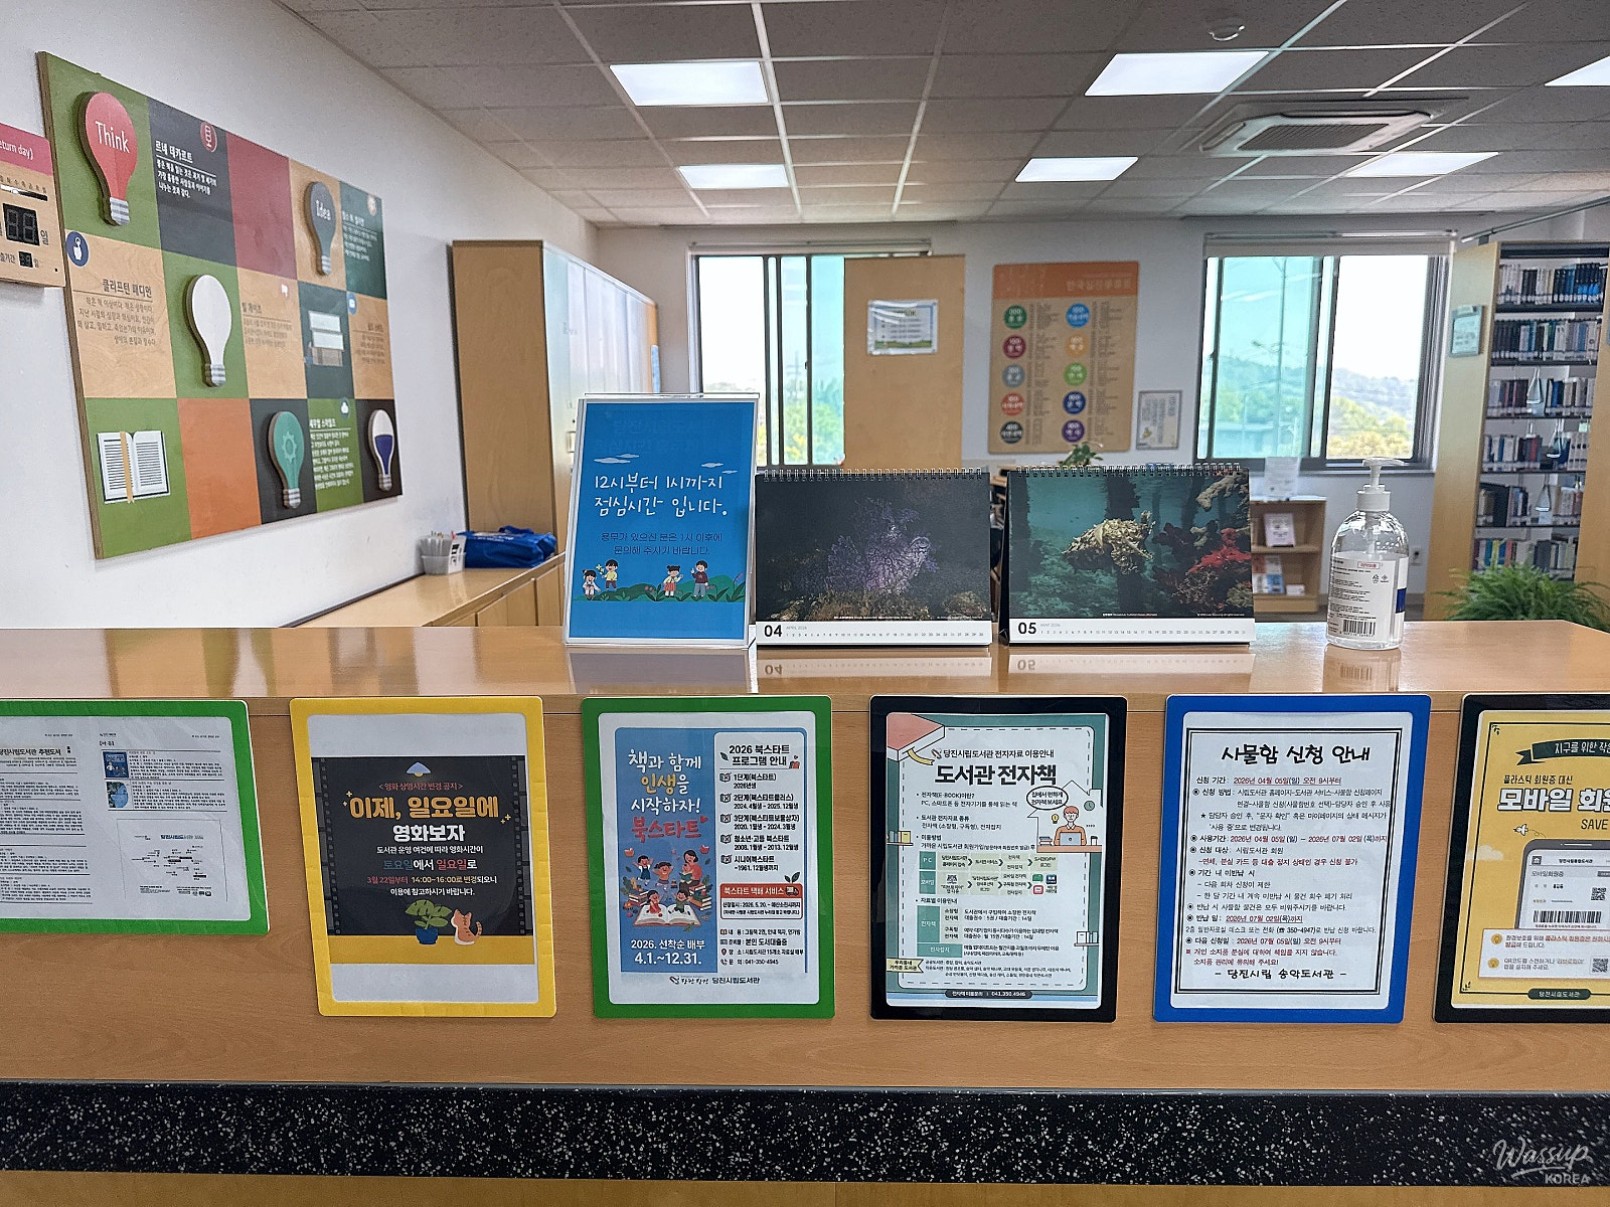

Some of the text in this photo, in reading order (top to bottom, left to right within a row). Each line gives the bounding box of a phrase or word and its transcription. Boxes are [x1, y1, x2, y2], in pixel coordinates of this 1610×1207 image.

[95, 121, 130, 153] Think
[18, 146, 33, 160] day)
[156, 140, 193, 163] 르네 데카르트
[316, 199, 331, 220] Idea
[103, 279, 130, 296] 클리프턴
[595, 472, 723, 494] 12시부터 1시까지
[595, 497, 728, 518] 점심시간 입니다.
[630, 532, 657, 542] 있으신
[660, 532, 677, 541] 분은
[696, 532, 723, 541] 이후에
[614, 546, 641, 555] 문의해
[644, 546, 670, 555] 주시기
[764, 624, 782, 637] 04
[1018, 622, 1037, 634] 05
[729, 745, 790, 754] 2026 북스타트
[943, 749, 1054, 758] 당진시립도서관 전자자료 이용안내
[1555, 741, 1579, 754] 지구를
[1581, 741, 1597, 753] 위한
[1222, 744, 1370, 765] 사물함 신청 안내
[628, 749, 701, 774] 책과 함께
[732, 756, 787, 766] 프로그램 안내
[935, 765, 1056, 785] 도서관 전자책
[1196, 776, 1209, 784] 신청
[1233, 776, 1256, 784] 2026년
[1257, 776, 1272, 784] 04월
[1503, 775, 1573, 784] 플라스틱 회원증 대신
[641, 773, 689, 795] 인생을
[1202, 788, 1216, 796] 신청
[631, 796, 700, 815] 시작하자!
[1497, 788, 1610, 812] 모바일 회
[350, 796, 498, 820] 이제, 일요일에
[632, 816, 702, 843] 북스타트
[1581, 819, 1608, 830] SAVE
[393, 825, 465, 842] 영화보자
[1230, 835, 1252, 843] 2026년
[1254, 835, 1268, 843] 04월
[1308, 835, 1329, 843] 2026년
[1332, 835, 1345, 843] 07월
[377, 846, 483, 854] 도서관 운영 여건에 따라 영화시간이
[384, 859, 477, 870] 토요일에서 일요일로
[1292, 858, 1311, 866] 상태인
[464, 876, 497, 884] 변경되오니
[390, 888, 475, 896] 이용에 참고하시기 바랍니다.
[631, 939, 705, 950] 2026. 선착순 배부
[635, 952, 702, 964] 4.1.~12.31.
[1227, 968, 1334, 979] 당진시립 송악도서관
